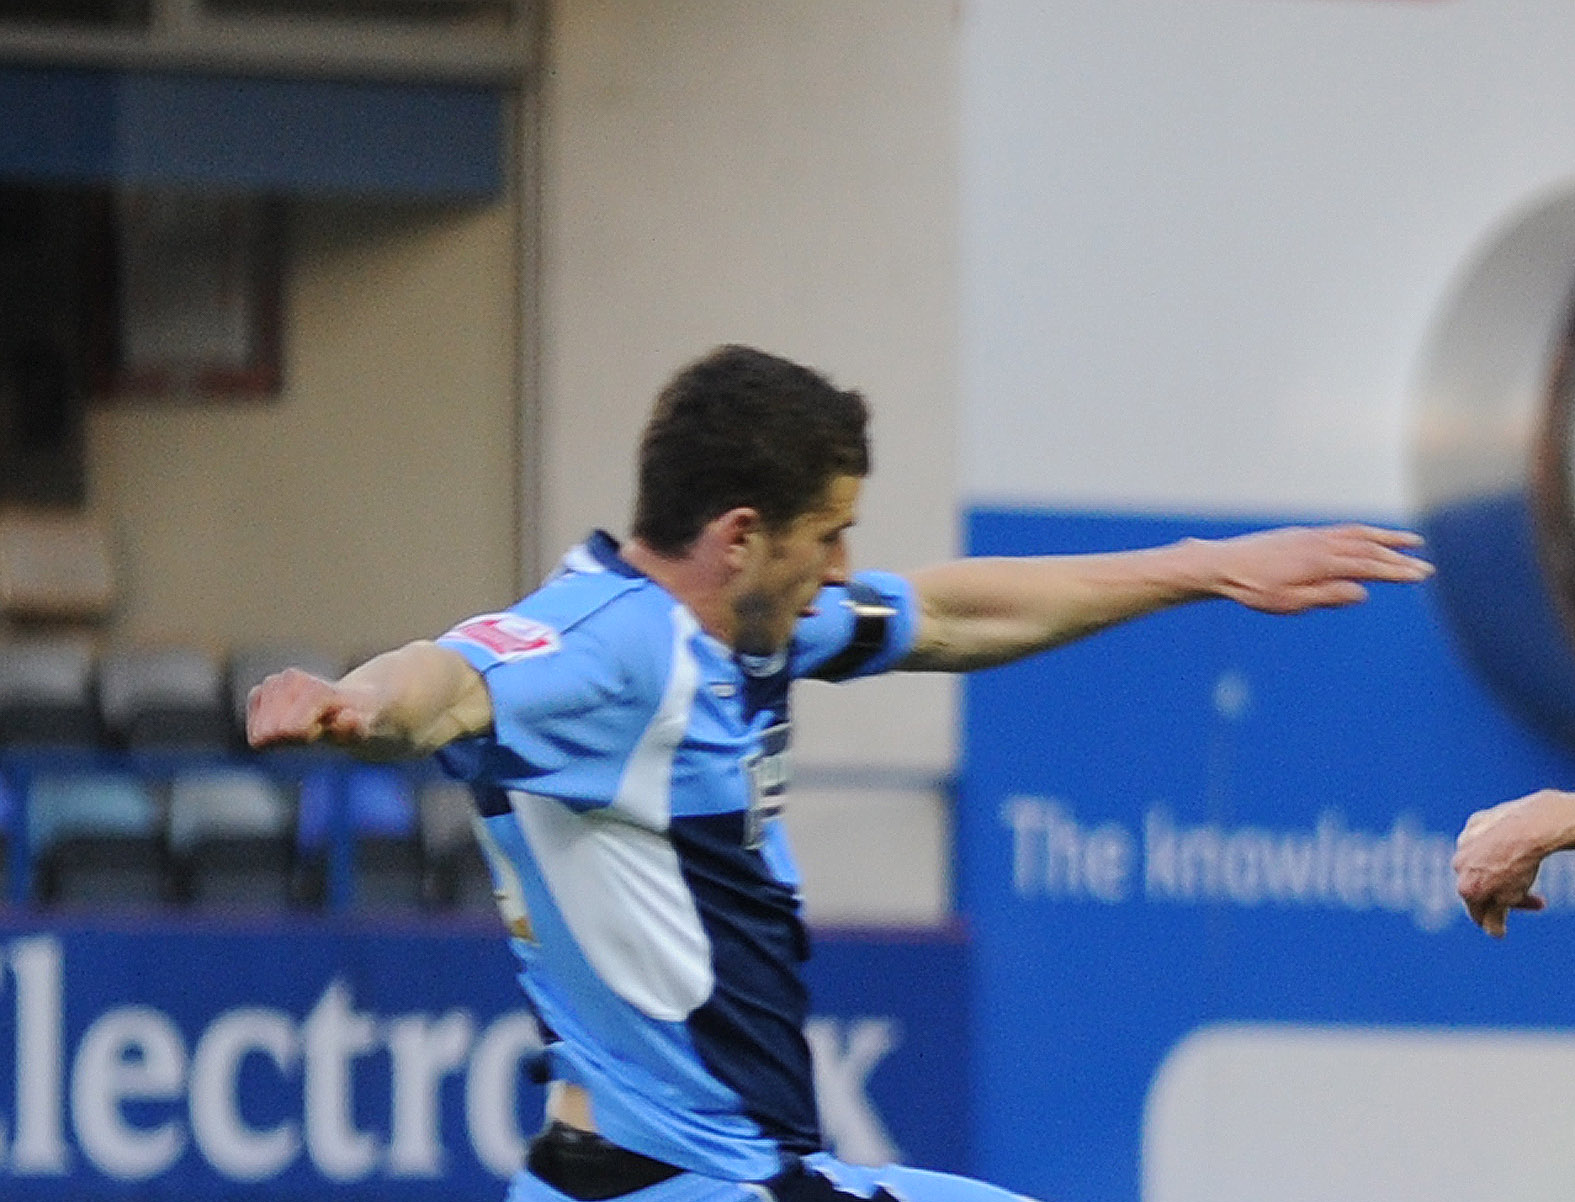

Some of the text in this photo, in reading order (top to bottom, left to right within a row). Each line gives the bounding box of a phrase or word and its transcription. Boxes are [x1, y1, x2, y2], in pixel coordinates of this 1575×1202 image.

[1004, 798, 1130, 901] The
[1145, 806, 1462, 930] knowledg
[0, 936, 903, 1178] lectrox
